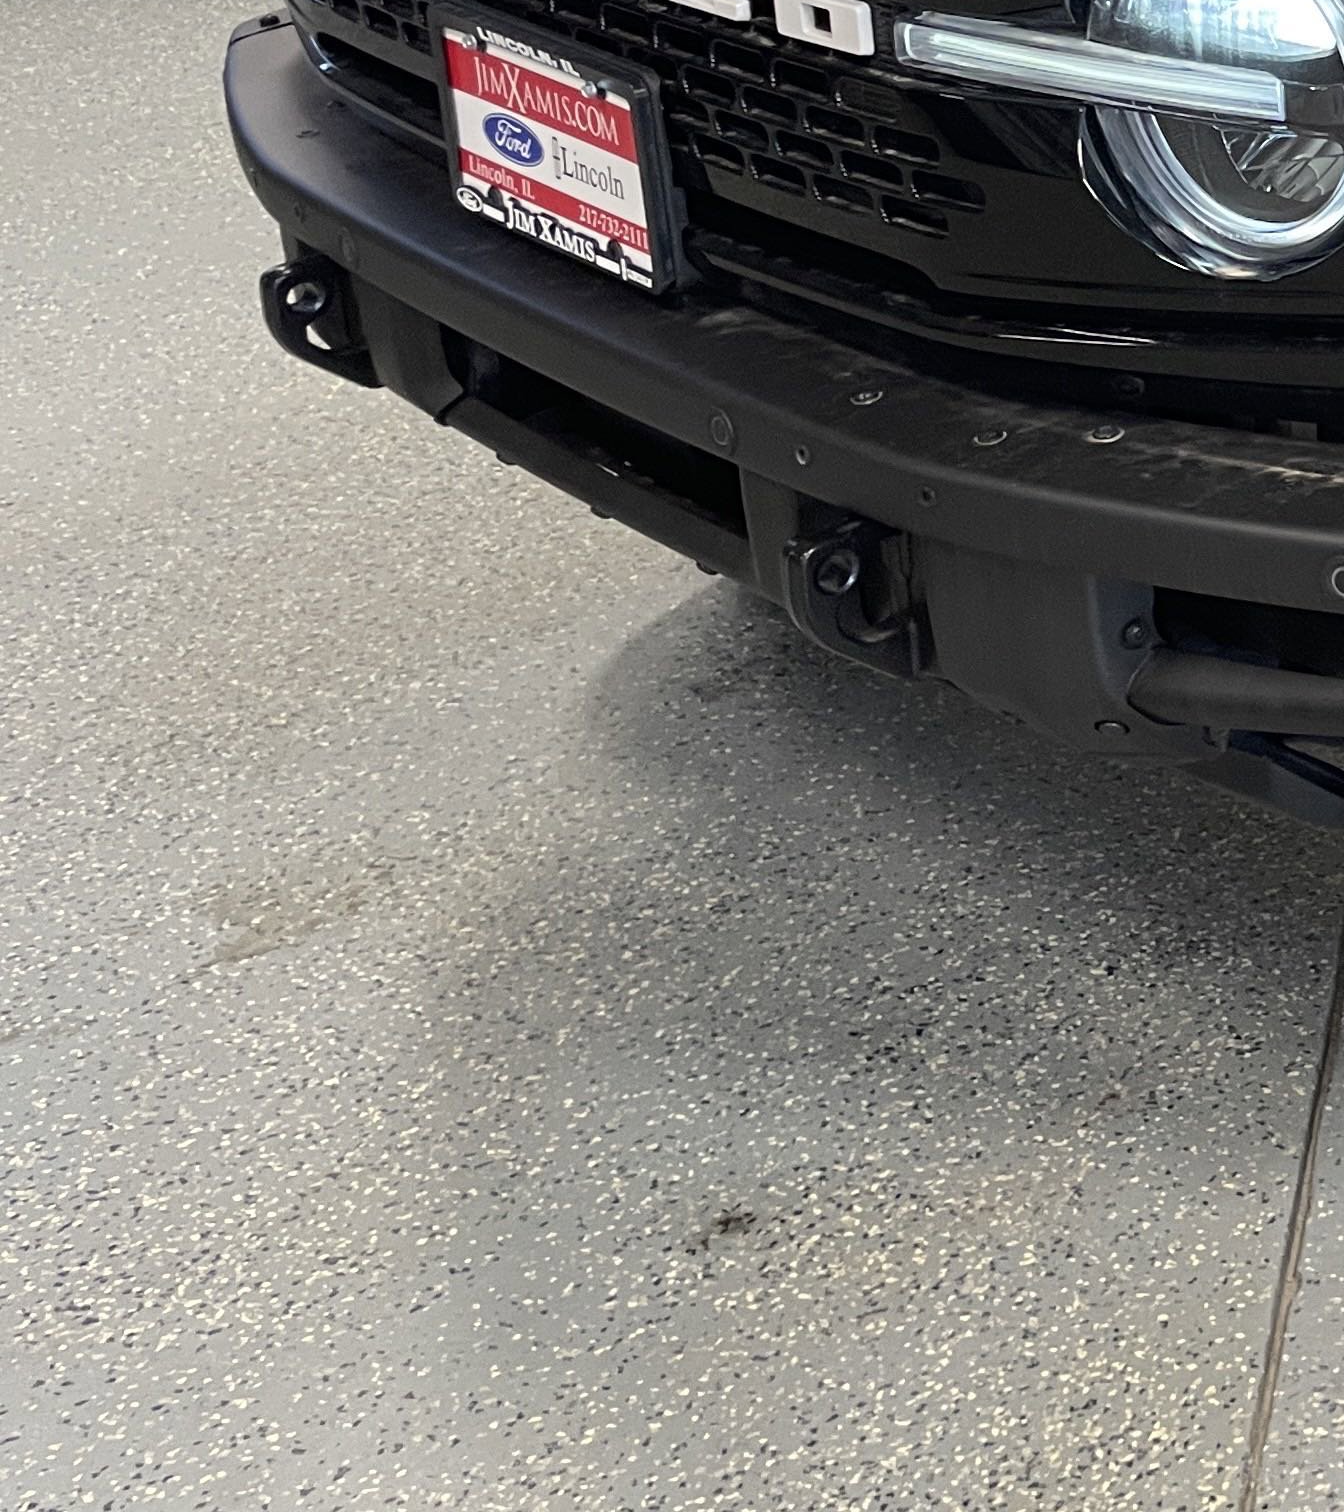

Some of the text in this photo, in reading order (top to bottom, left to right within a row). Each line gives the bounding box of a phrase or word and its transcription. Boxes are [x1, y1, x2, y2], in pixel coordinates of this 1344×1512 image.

[560, 59, 581, 78] IL
[474, 57, 620, 146] JIMXAMIS.COM
[495, 119, 532, 160] Ford
[562, 147, 625, 201] Lincoln
[506, 204, 596, 263] JIM XAMIS
[578, 204, 650, 250] 217-732-2111
